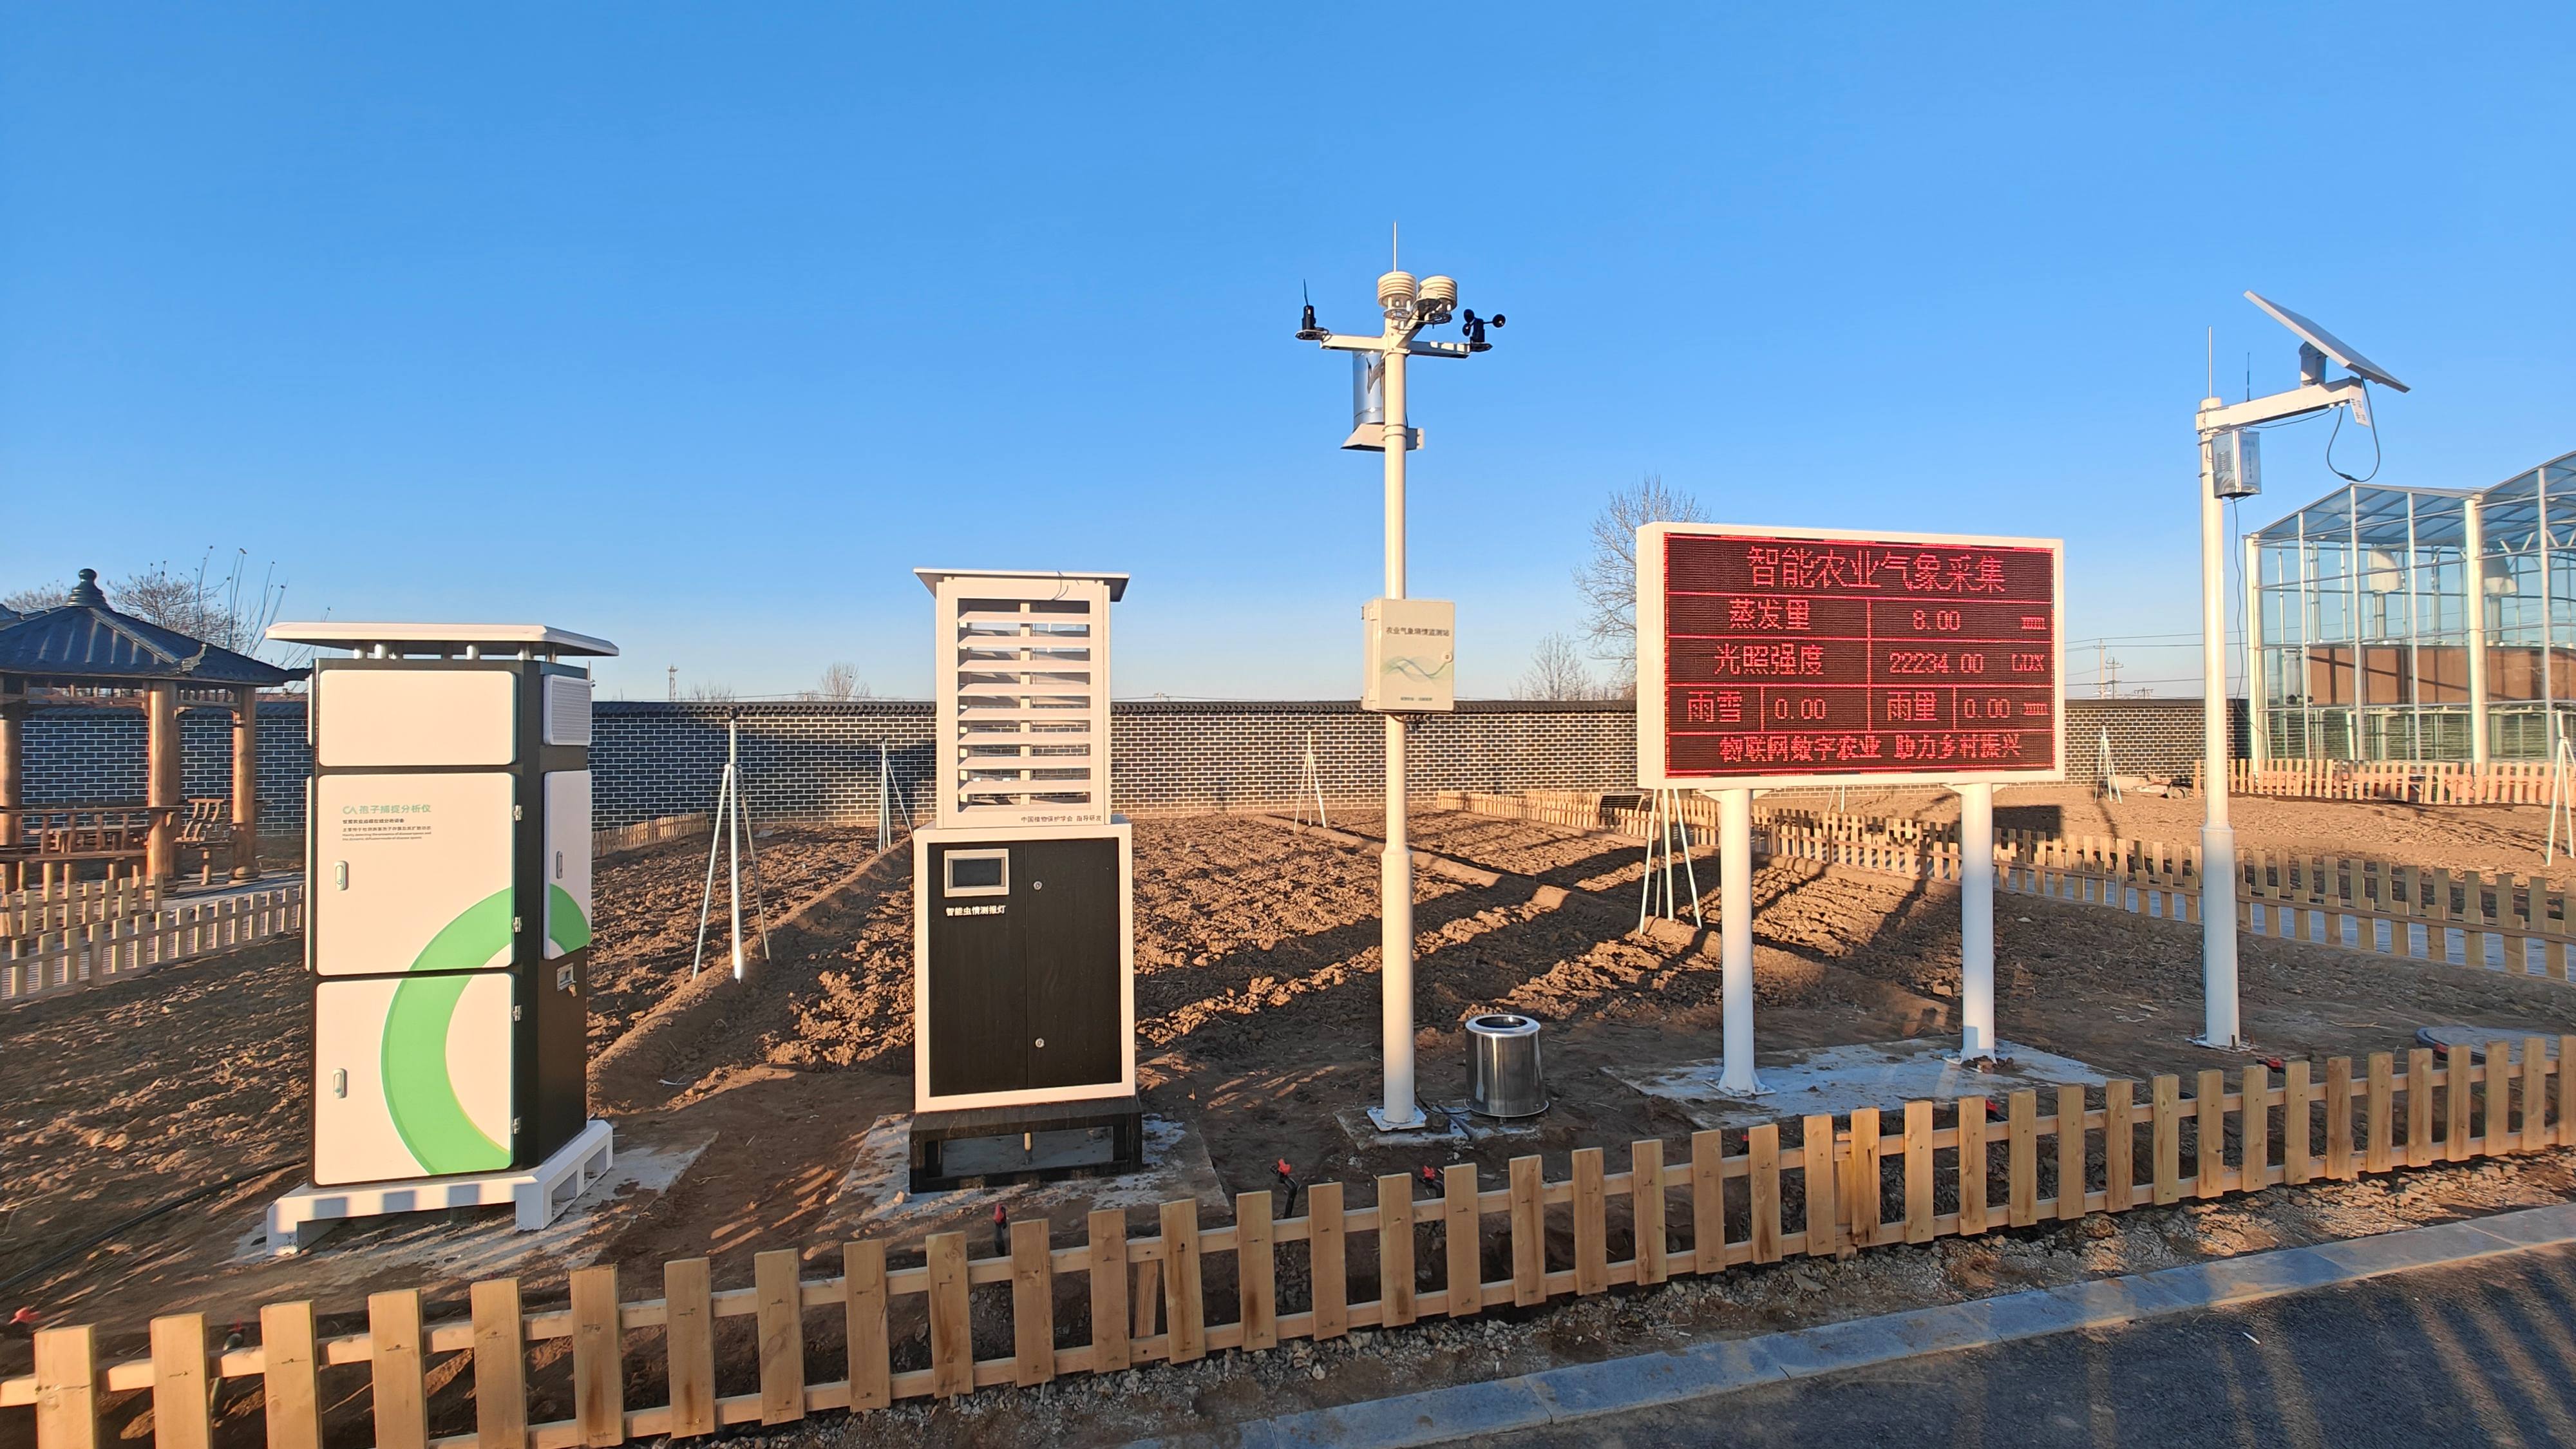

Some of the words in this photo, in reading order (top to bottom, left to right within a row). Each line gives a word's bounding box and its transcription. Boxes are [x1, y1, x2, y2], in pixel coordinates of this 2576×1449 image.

[1747, 545, 2005, 594] 智能农业气象采集
[1729, 598, 1811, 630] 蒸发量
[1913, 610, 1961, 630] 8.00
[1714, 643, 1824, 675] 光照强度
[1889, 652, 1984, 674] 22234.00
[1688, 691, 1743, 723] 雨雪
[1775, 698, 1826, 720] 0.00
[1964, 698, 2011, 718] 0.00
[1719, 735, 1882, 762] 物联网数字农业
[1893, 734, 2022, 760] 助力乡村振兴
[945, 904, 1006, 917] 智能虫情测报灯
